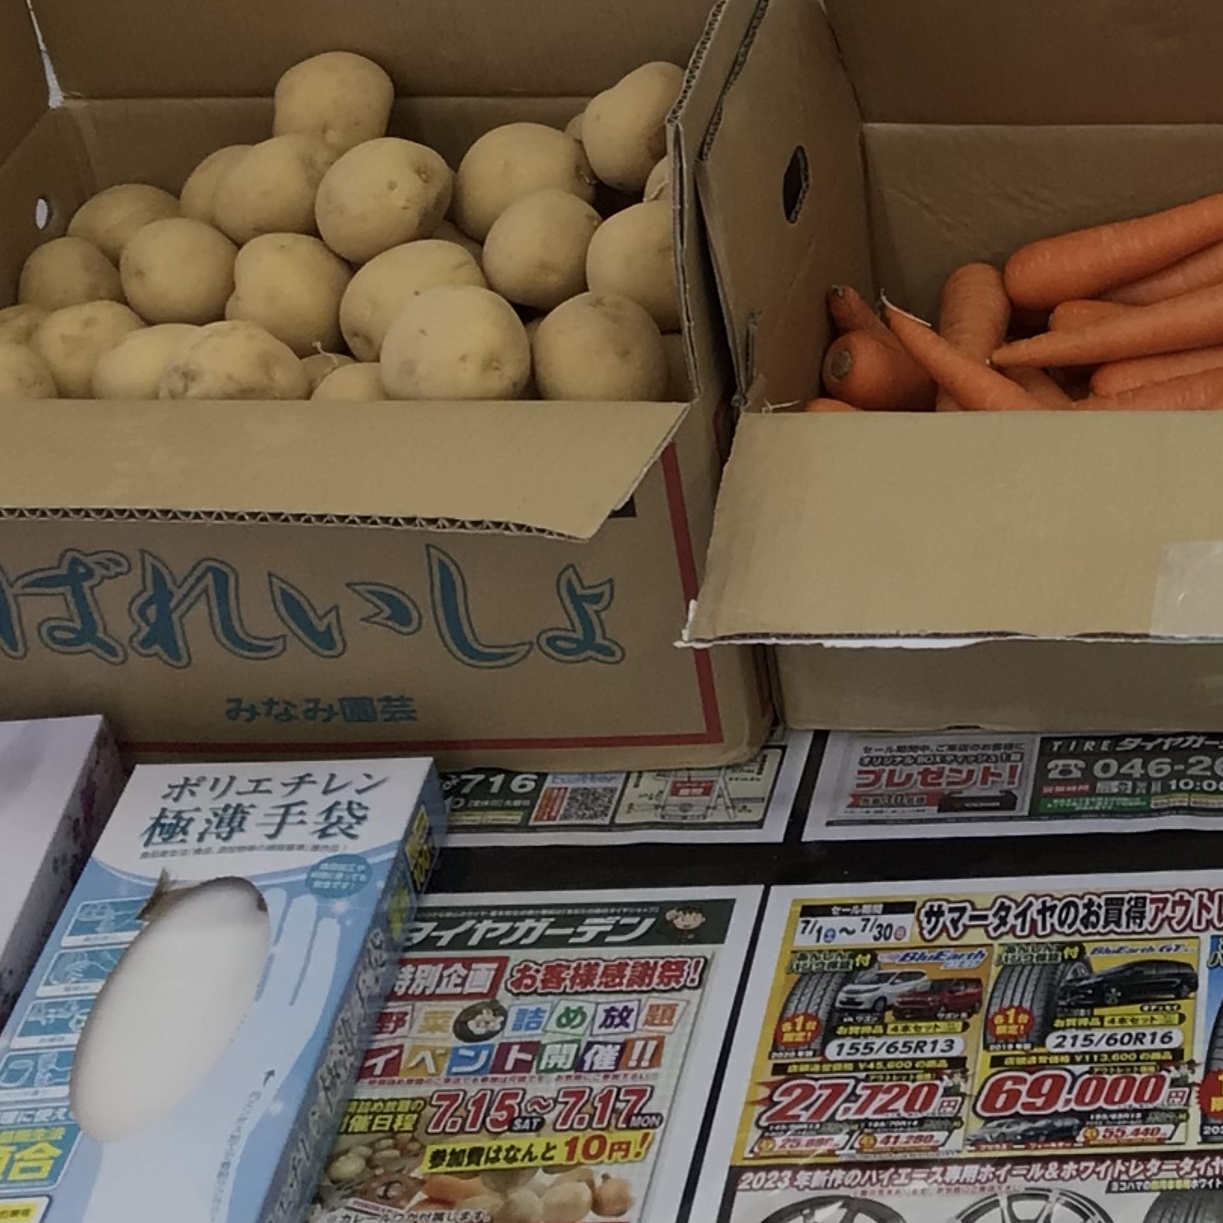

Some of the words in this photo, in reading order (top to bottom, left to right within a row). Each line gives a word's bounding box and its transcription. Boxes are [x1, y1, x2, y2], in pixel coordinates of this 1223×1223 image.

[225, 696, 418, 723] みなみ園芸
[1052, 741, 1111, 752] TIRE
[855, 765, 1020, 789] プレゼント!
[161, 773, 391, 802] ポリエチレン
[140, 800, 370, 847] 極薄手袋
[831, 904, 883, 915] セール期間
[899, 949, 986, 962] BluEarth
[508, 958, 703, 993] お客様感謝祭!
[835, 1038, 955, 1056] 155/65R13
[1054, 1030, 1174, 1049] 215/60R16
[364, 1039, 656, 1075] イベント開催!!
[341, 1114, 417, 1132] 催日程
[512, 1118, 541, 1130] SAT
[630, 1114, 660, 1127] MON
